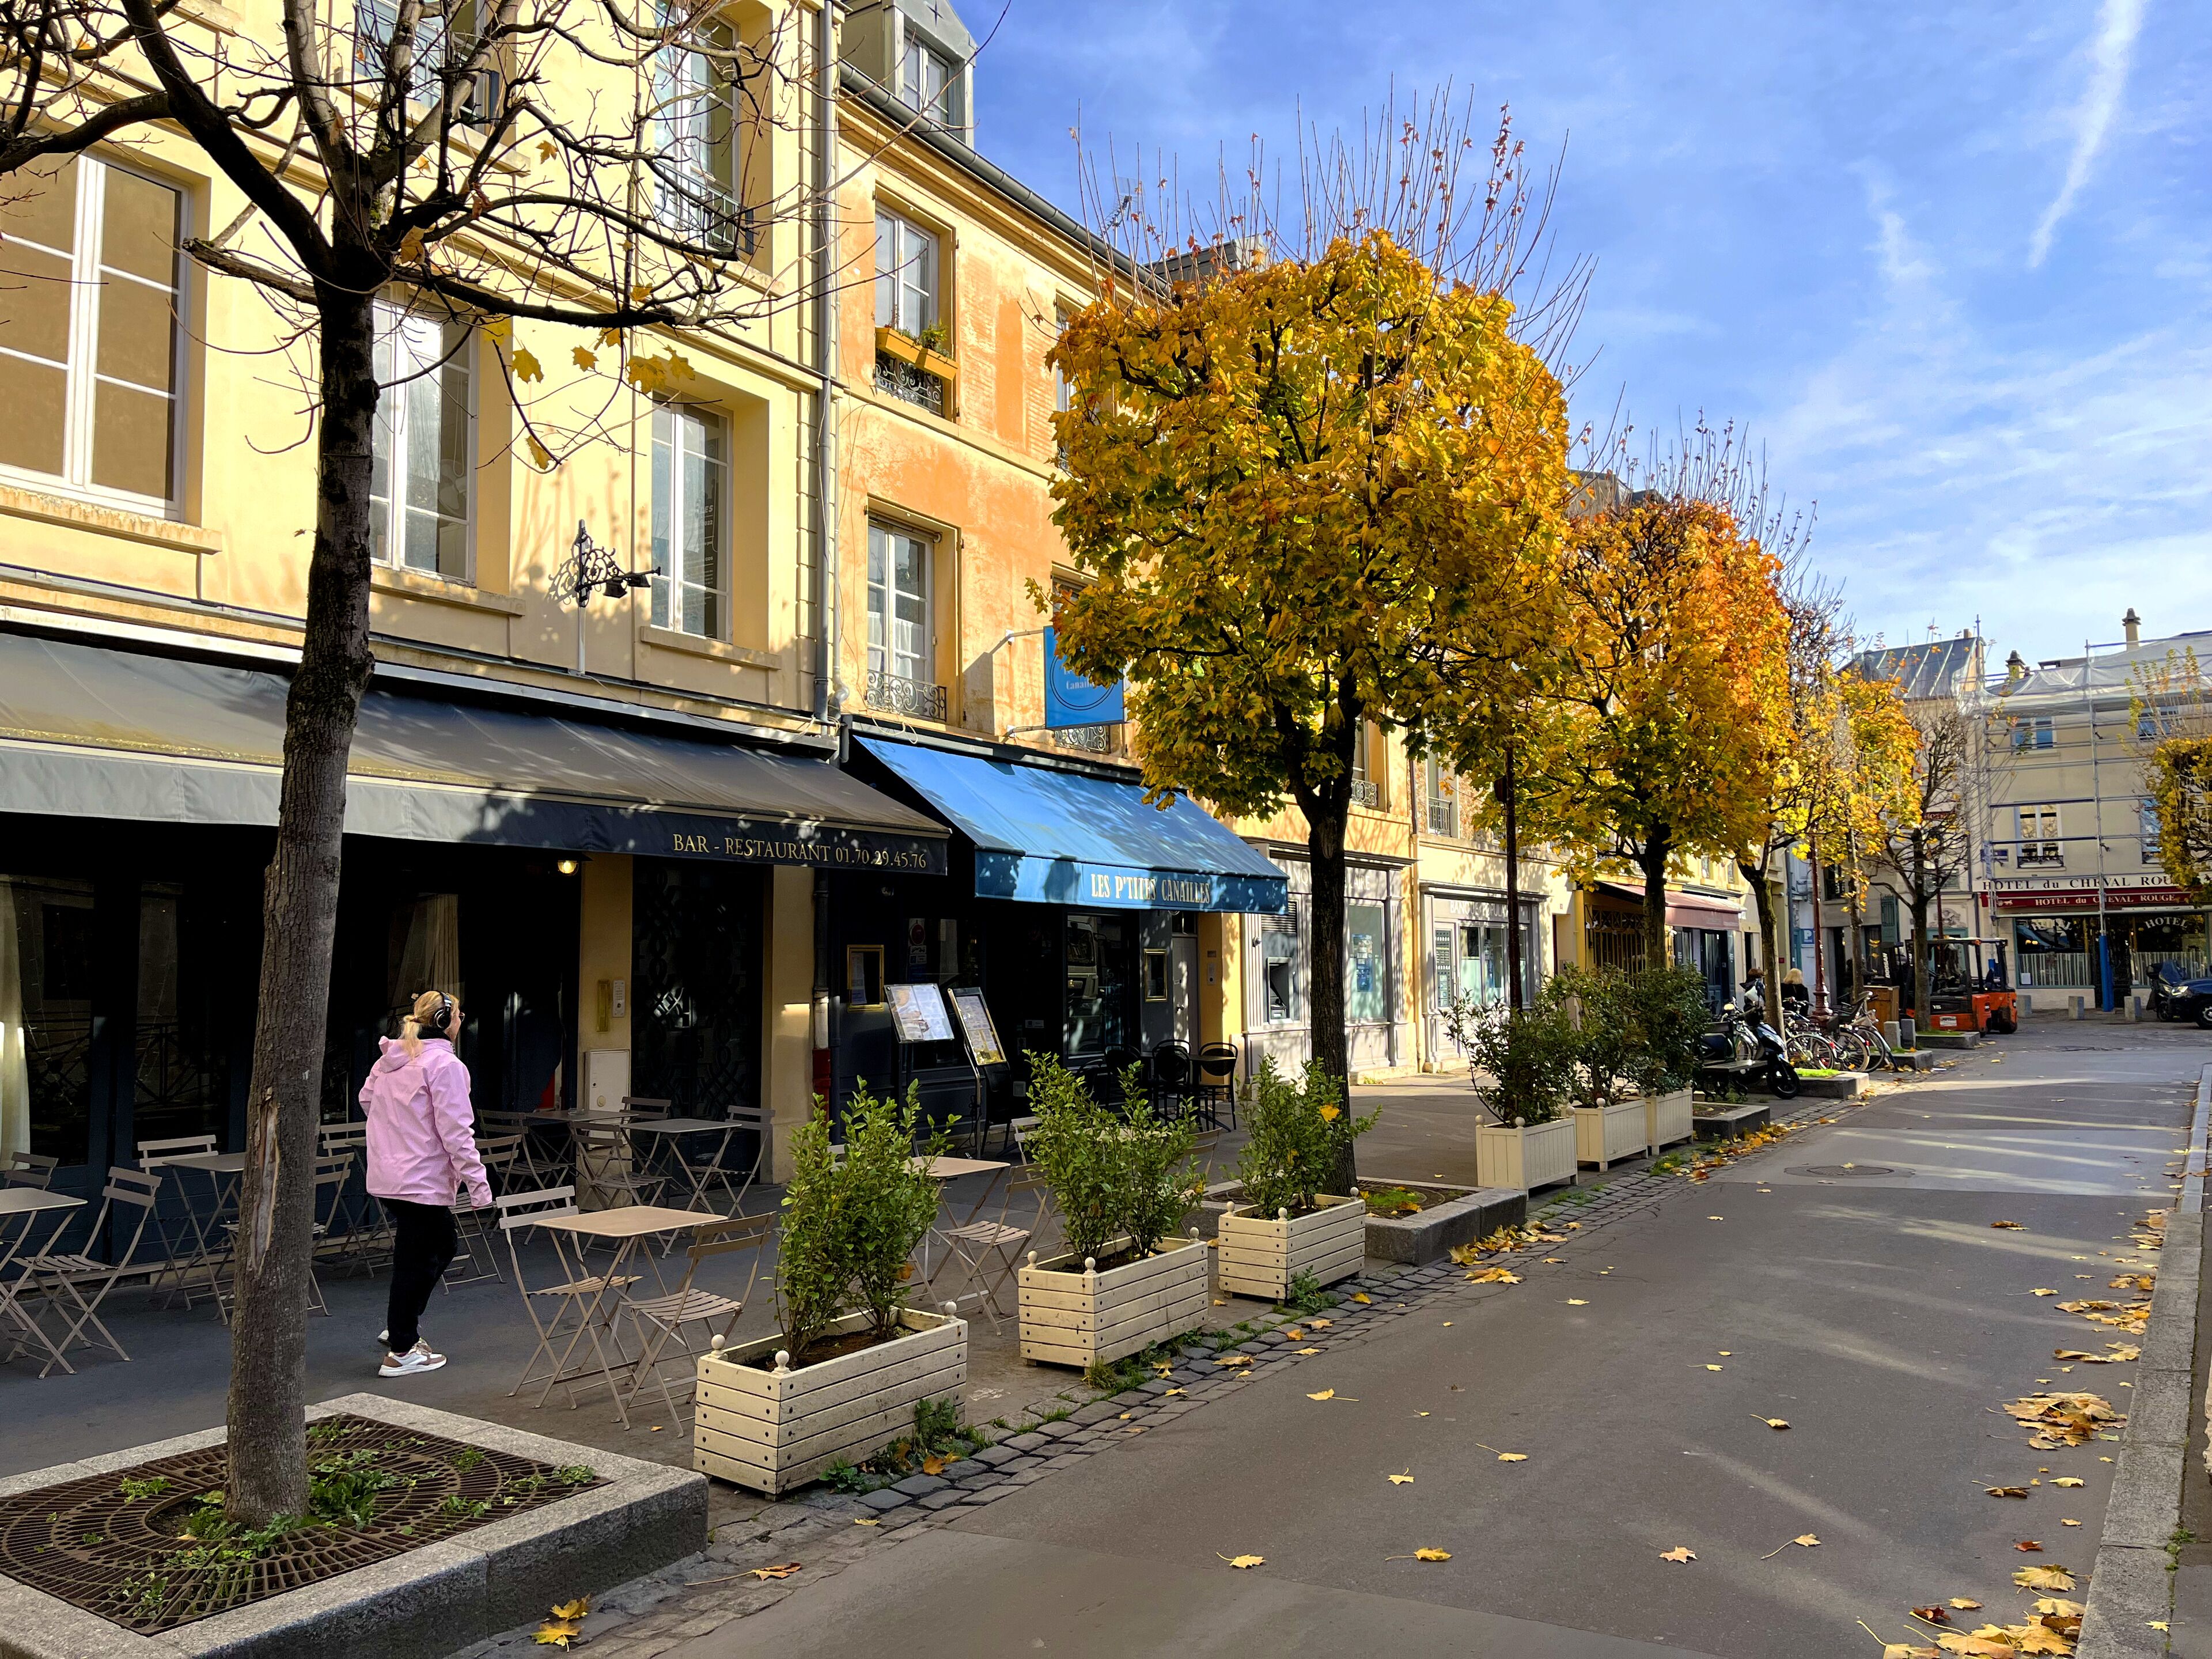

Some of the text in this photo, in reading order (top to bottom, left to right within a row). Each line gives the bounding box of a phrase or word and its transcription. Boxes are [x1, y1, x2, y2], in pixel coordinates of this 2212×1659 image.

[673, 834, 710, 853] BAR
[724, 838, 831, 862] RESTAURANT
[835, 847, 926, 869] 01.70.29.45.76
[1090, 873, 1210, 904] LES P'TITES CANAILLES
[1983, 880, 2034, 891] HOTEL
[2043, 880, 2059, 889] du
[2141, 876, 2172, 886] ROU
[2035, 897, 2070, 906] HOTEL
[2093, 895, 2134, 904] CEVAL
[2141, 893, 2177, 902] ROUGE
[2145, 917, 2189, 929] HOTEL
[1804, 930, 1812, 940] P
